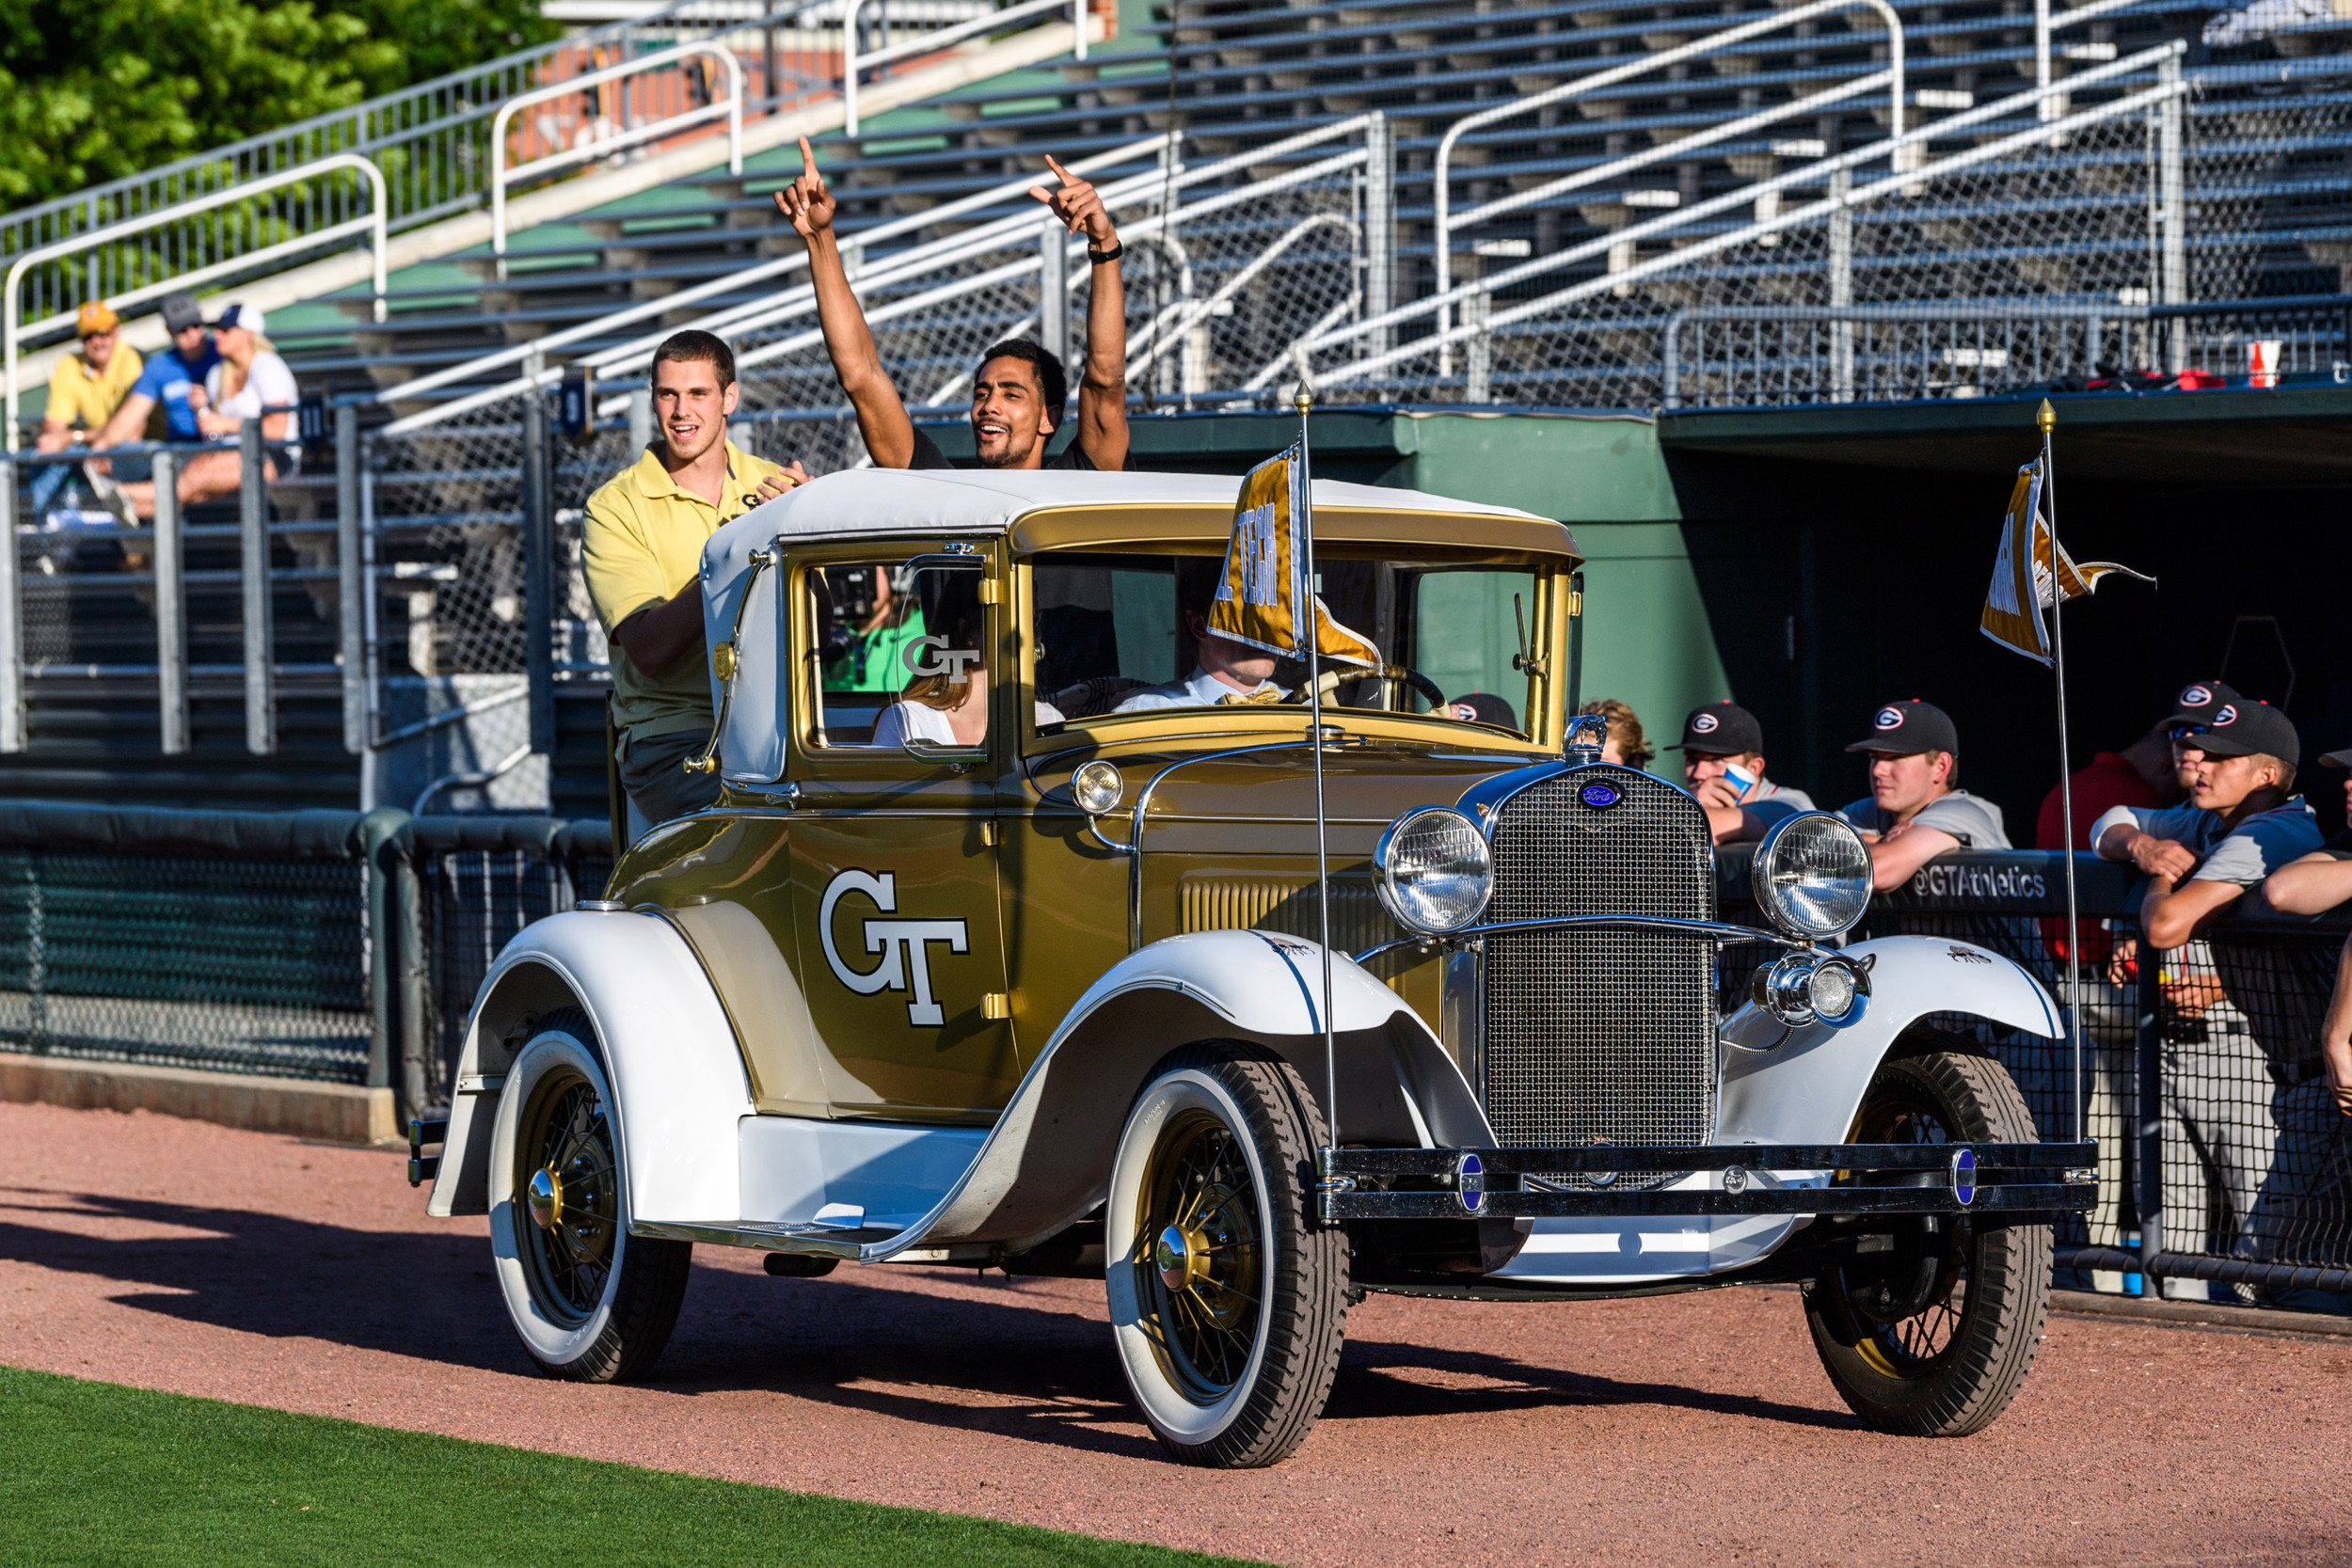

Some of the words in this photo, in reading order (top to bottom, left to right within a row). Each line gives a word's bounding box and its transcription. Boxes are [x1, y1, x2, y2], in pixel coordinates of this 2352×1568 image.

[1238, 502, 1278, 607] TECH
[902, 634, 980, 684] GT
[1583, 788, 1612, 802] Ford
[1914, 864, 2047, 898] @GTAthletics
[818, 866, 970, 1028] GT
